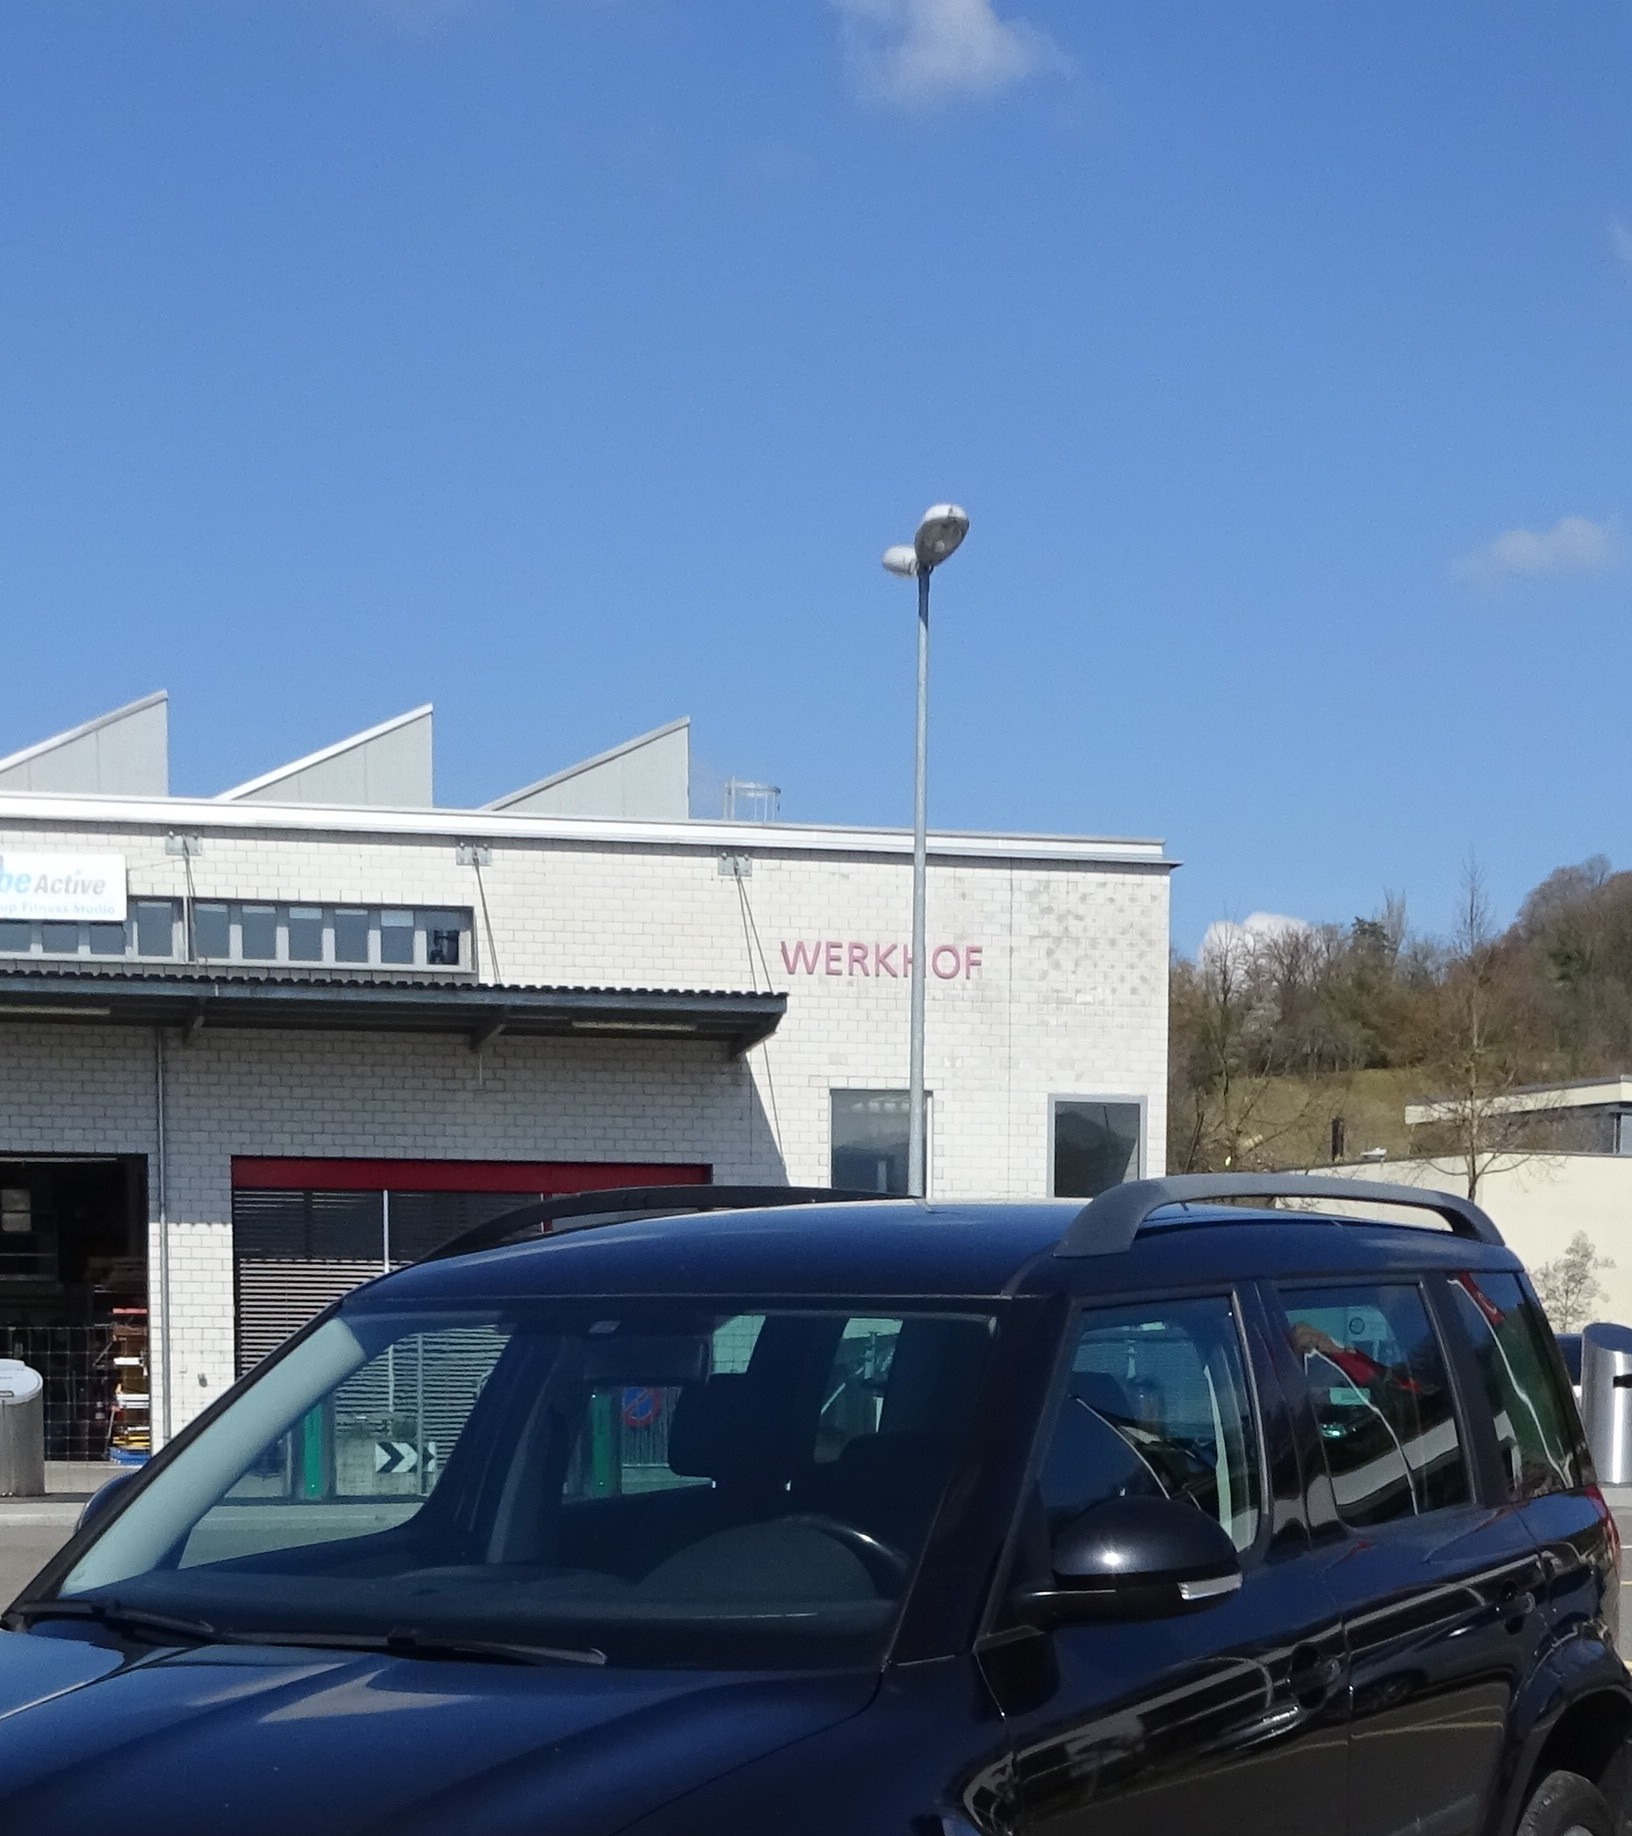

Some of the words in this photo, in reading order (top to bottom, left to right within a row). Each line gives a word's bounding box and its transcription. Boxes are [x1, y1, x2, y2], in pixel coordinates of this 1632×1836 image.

[33, 869, 106, 895] Active
[22, 902, 68, 914] Fitness
[73, 903, 116, 915] Studio
